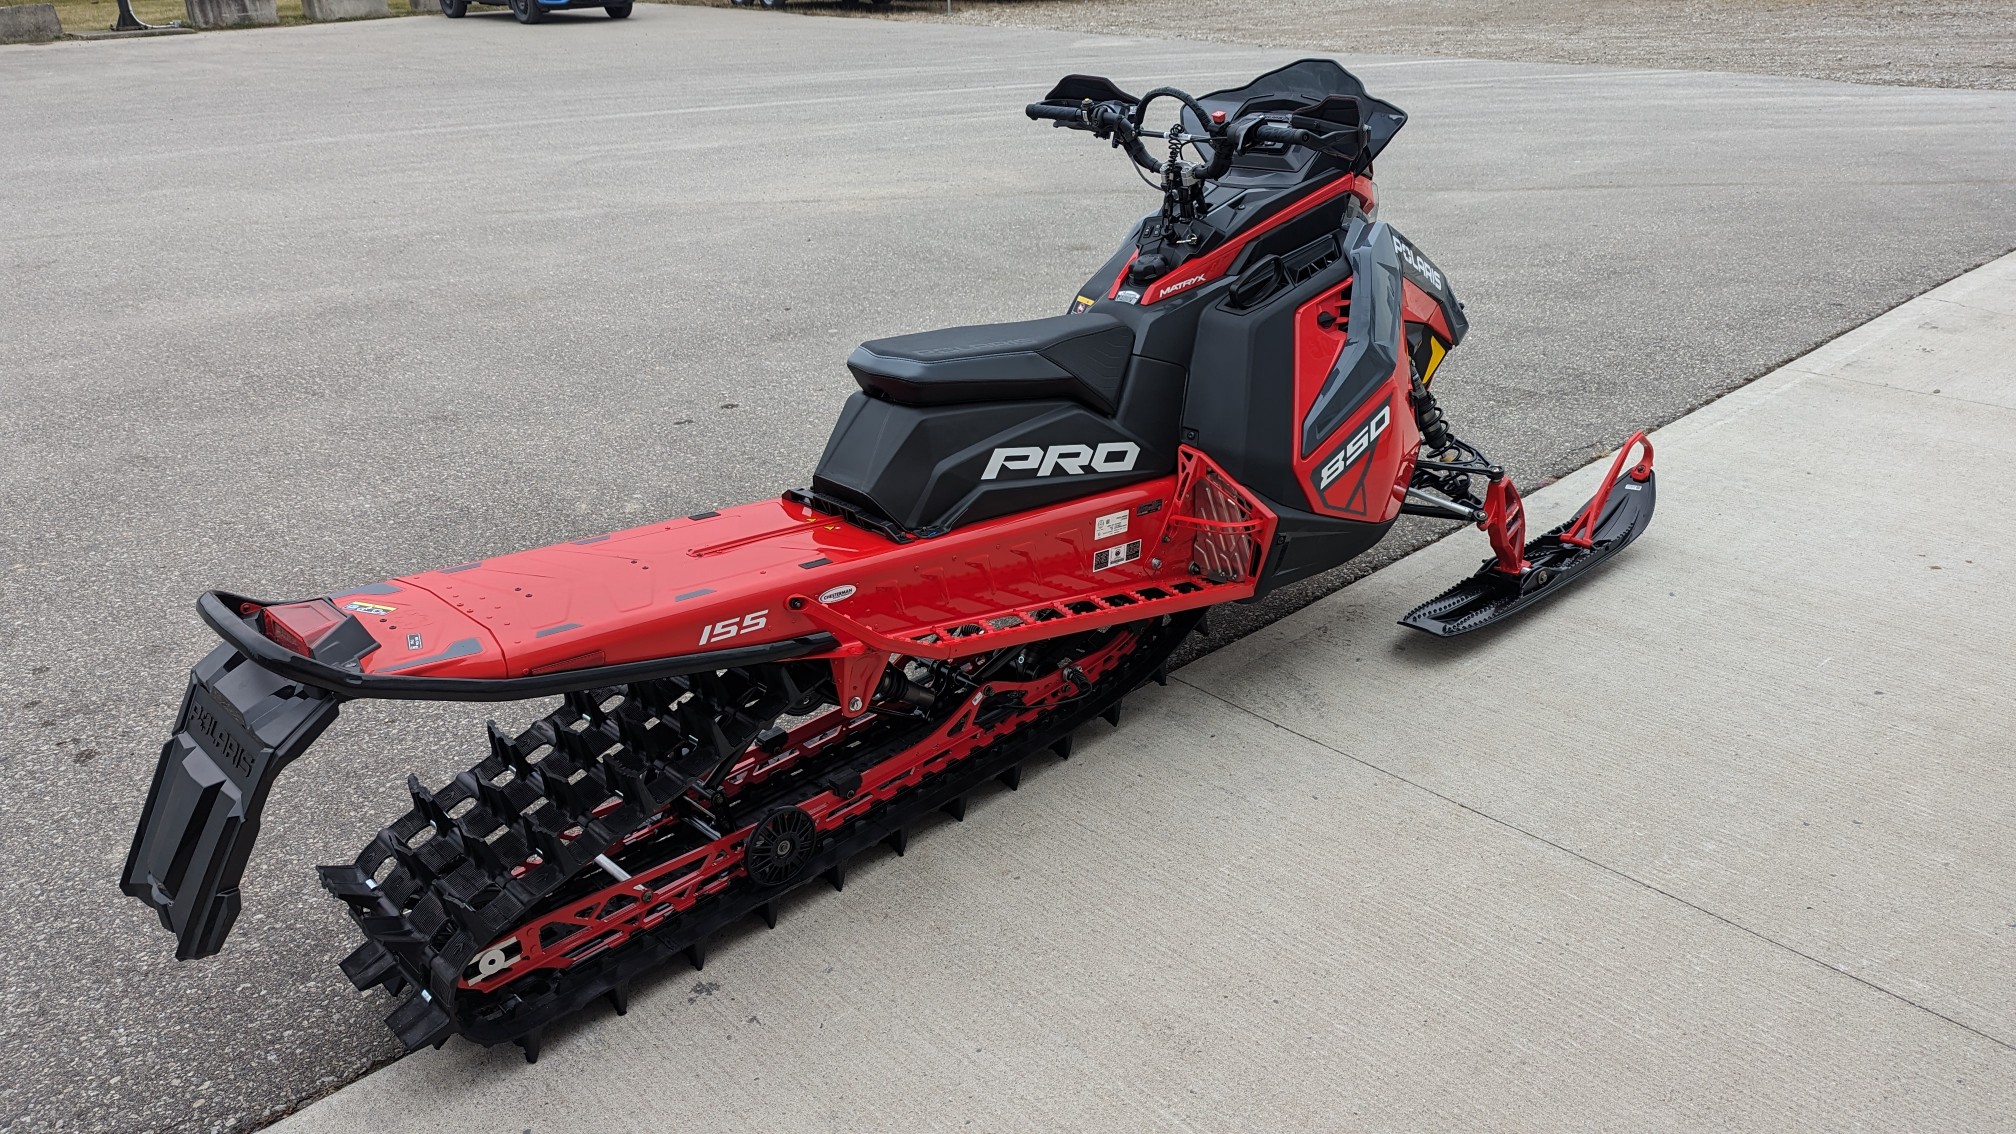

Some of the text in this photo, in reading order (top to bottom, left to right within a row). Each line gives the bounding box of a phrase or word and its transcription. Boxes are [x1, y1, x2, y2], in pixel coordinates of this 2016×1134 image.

[1159, 273, 1207, 298] MATRYX
[1392, 235, 1442, 291] POLARIS
[980, 441, 1141, 480] PRO
[1320, 405, 1391, 490] 850
[698, 609, 769, 646] 155
[189, 702, 256, 778] POLARIS
